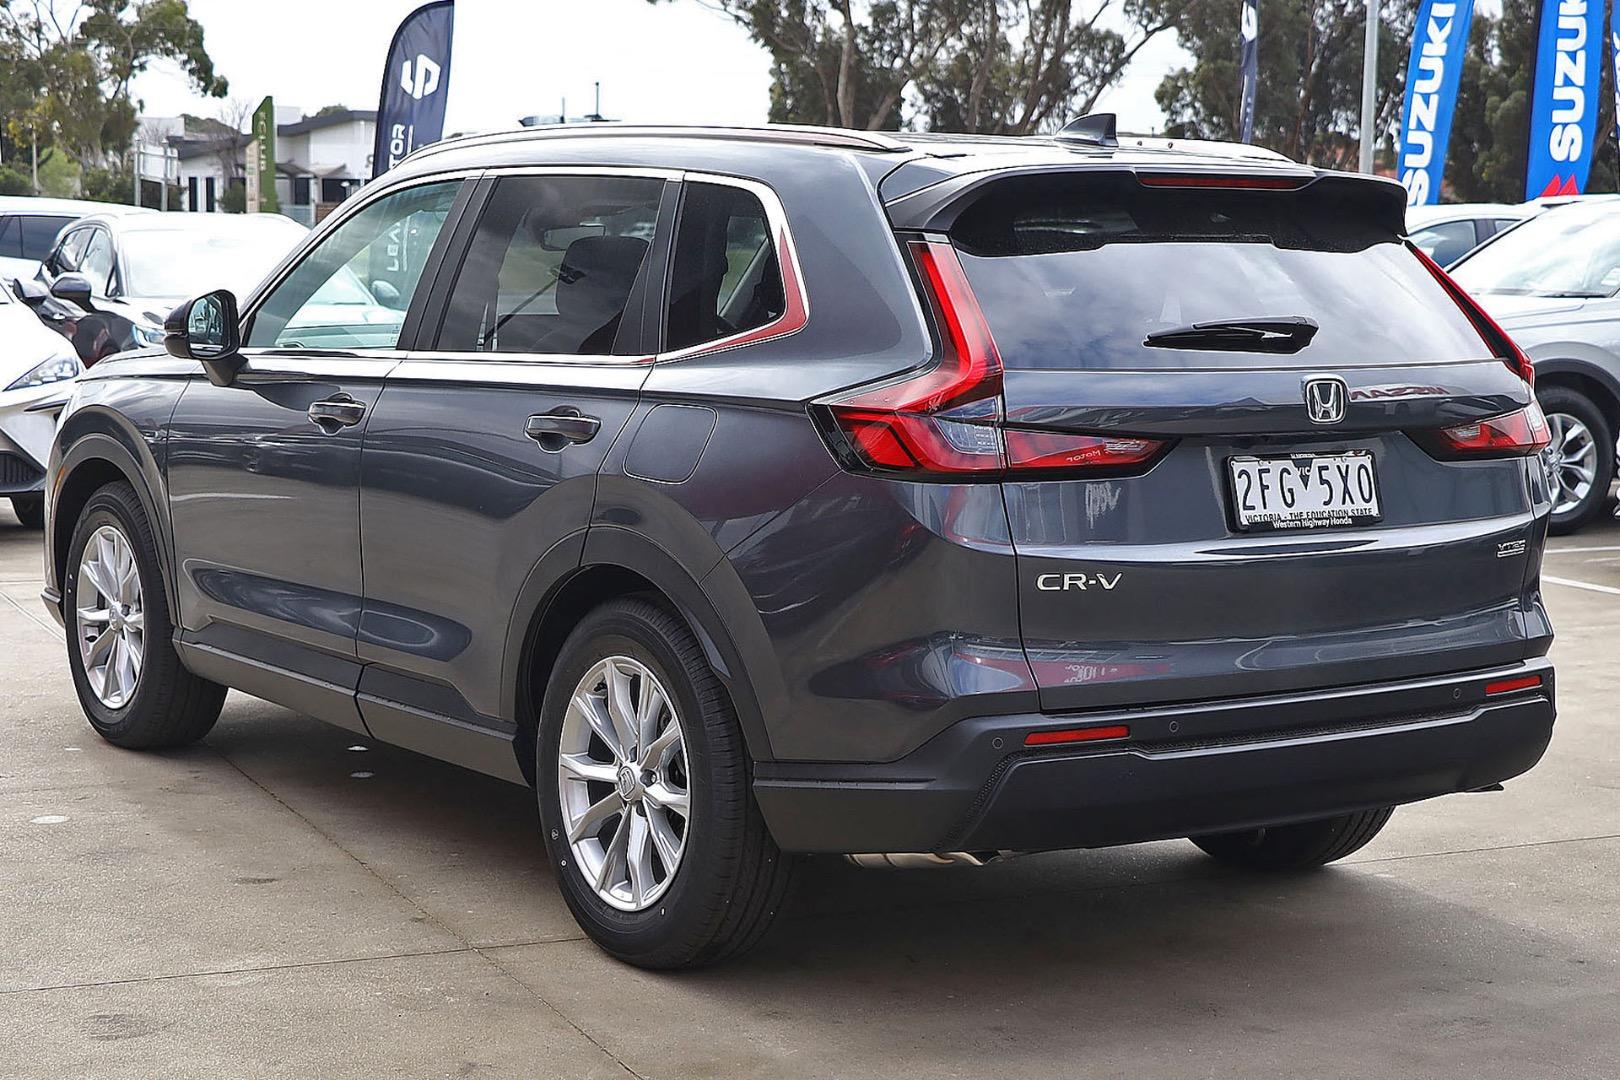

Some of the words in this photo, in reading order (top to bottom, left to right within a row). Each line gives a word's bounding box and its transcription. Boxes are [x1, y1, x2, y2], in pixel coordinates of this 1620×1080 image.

[1402, 3, 1457, 206] SUZUKI
[1297, 467, 1311, 476] VIC
[1237, 467, 1296, 511] 2FG
[1245, 513, 1281, 523] VICTORIA
[1289, 511, 1304, 520] THE
[1351, 507, 1373, 516] STATE
[1272, 519, 1301, 529] Western
[1302, 517, 1330, 528] Highway
[1331, 516, 1353, 525] Honda
[1037, 573, 1122, 590] CR-V
